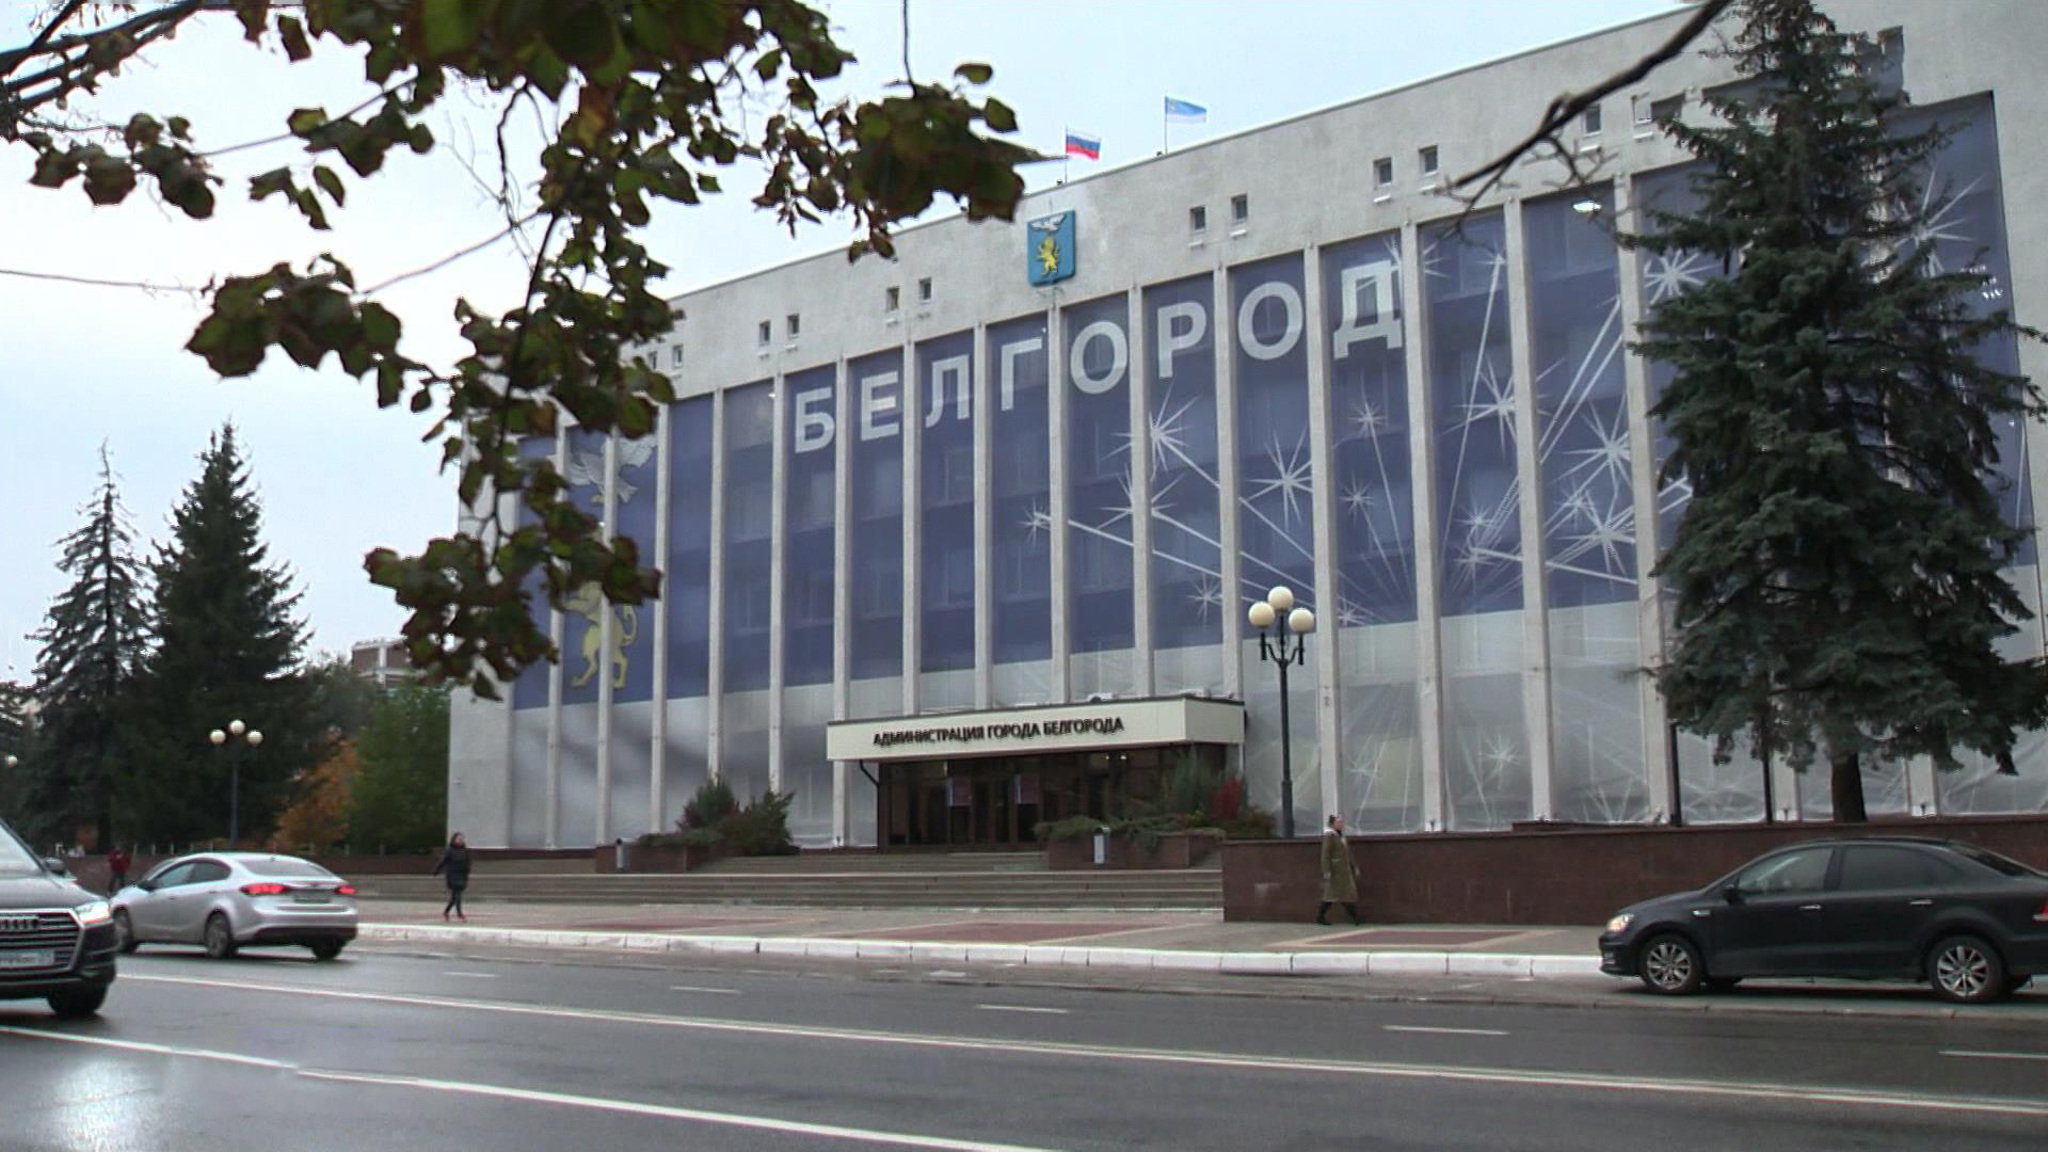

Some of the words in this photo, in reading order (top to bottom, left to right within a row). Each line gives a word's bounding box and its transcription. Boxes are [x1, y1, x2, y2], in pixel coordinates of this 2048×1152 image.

[794, 258, 1403, 454] БЕЛГОРОД
[873, 725, 984, 747] АДМИНИСТРАЦИЯ
[987, 722, 1041, 739] ГОРОДА
[1043, 717, 1124, 736] БЕЛГОРОДА
